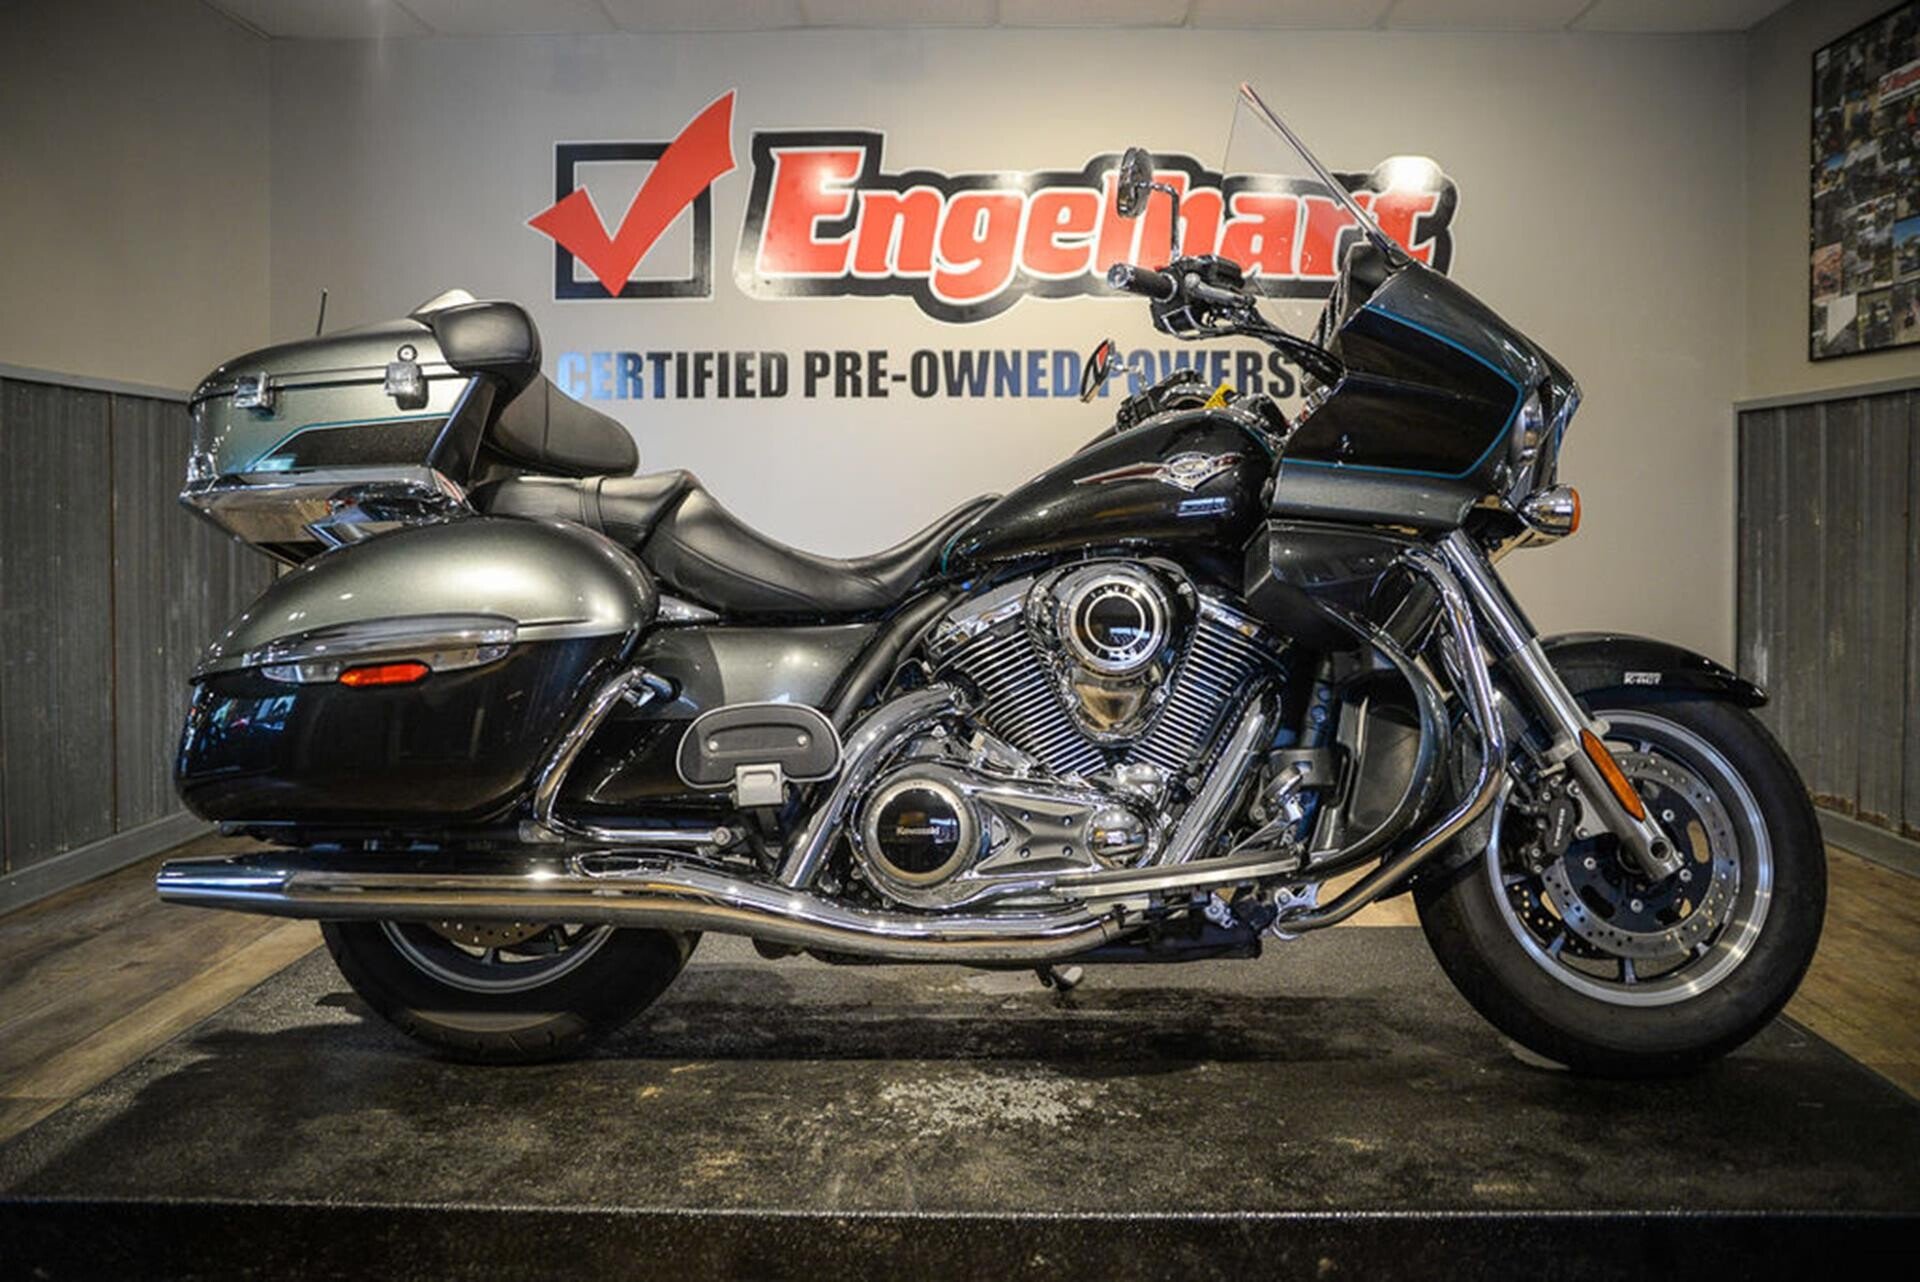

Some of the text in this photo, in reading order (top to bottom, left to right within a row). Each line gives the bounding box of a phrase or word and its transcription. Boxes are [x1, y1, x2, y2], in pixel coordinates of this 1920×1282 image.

[754, 145, 1443, 303] Engelhart
[557, 350, 789, 400] CERTIFIED
[803, 349, 1081, 399] PRE-OWNED
